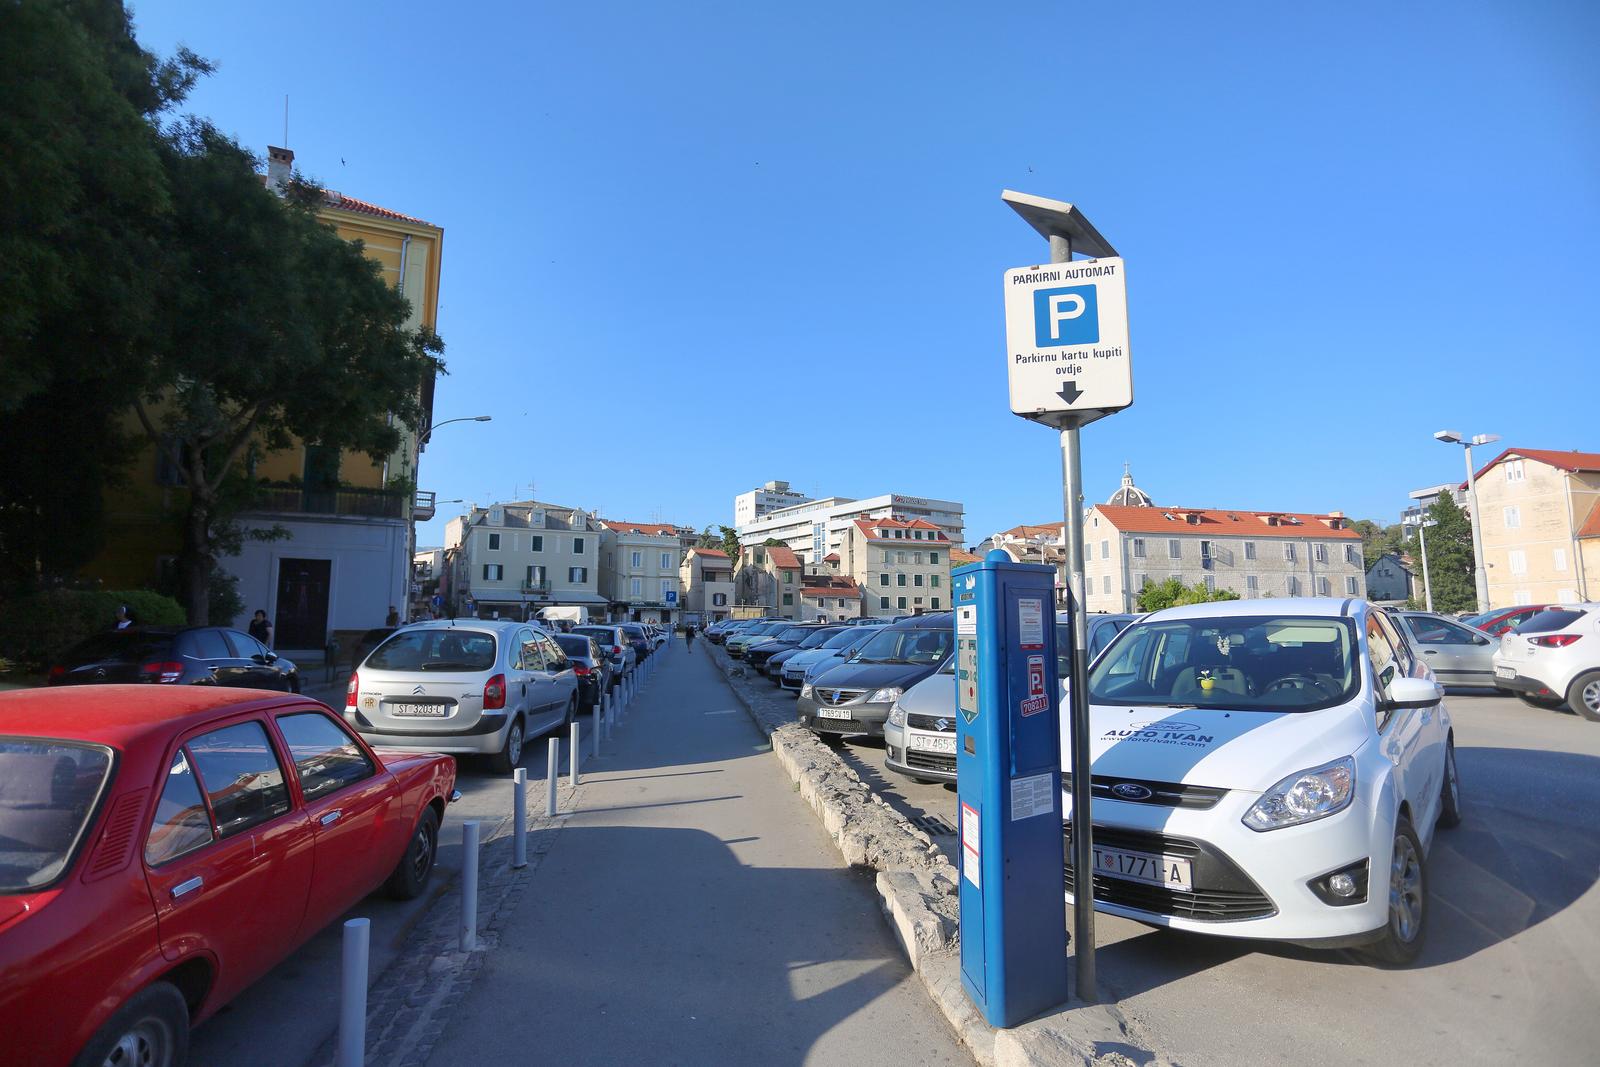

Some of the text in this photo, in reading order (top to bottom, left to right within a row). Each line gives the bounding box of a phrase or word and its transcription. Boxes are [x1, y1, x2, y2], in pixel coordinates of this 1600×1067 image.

[1013, 265, 1116, 285] PARKIRNI AUTOMAT
[1049, 294, 1086, 339] P
[1016, 347, 1122, 364] Parkirnu kartu kupiti
[1055, 364, 1082, 376] ovdje
[668, 592, 674, 600] P
[398, 704, 408, 713] ST
[1100, 736, 1206, 748] www.ford-ivan.com
[1104, 729, 1215, 743] AUTO IVAN
